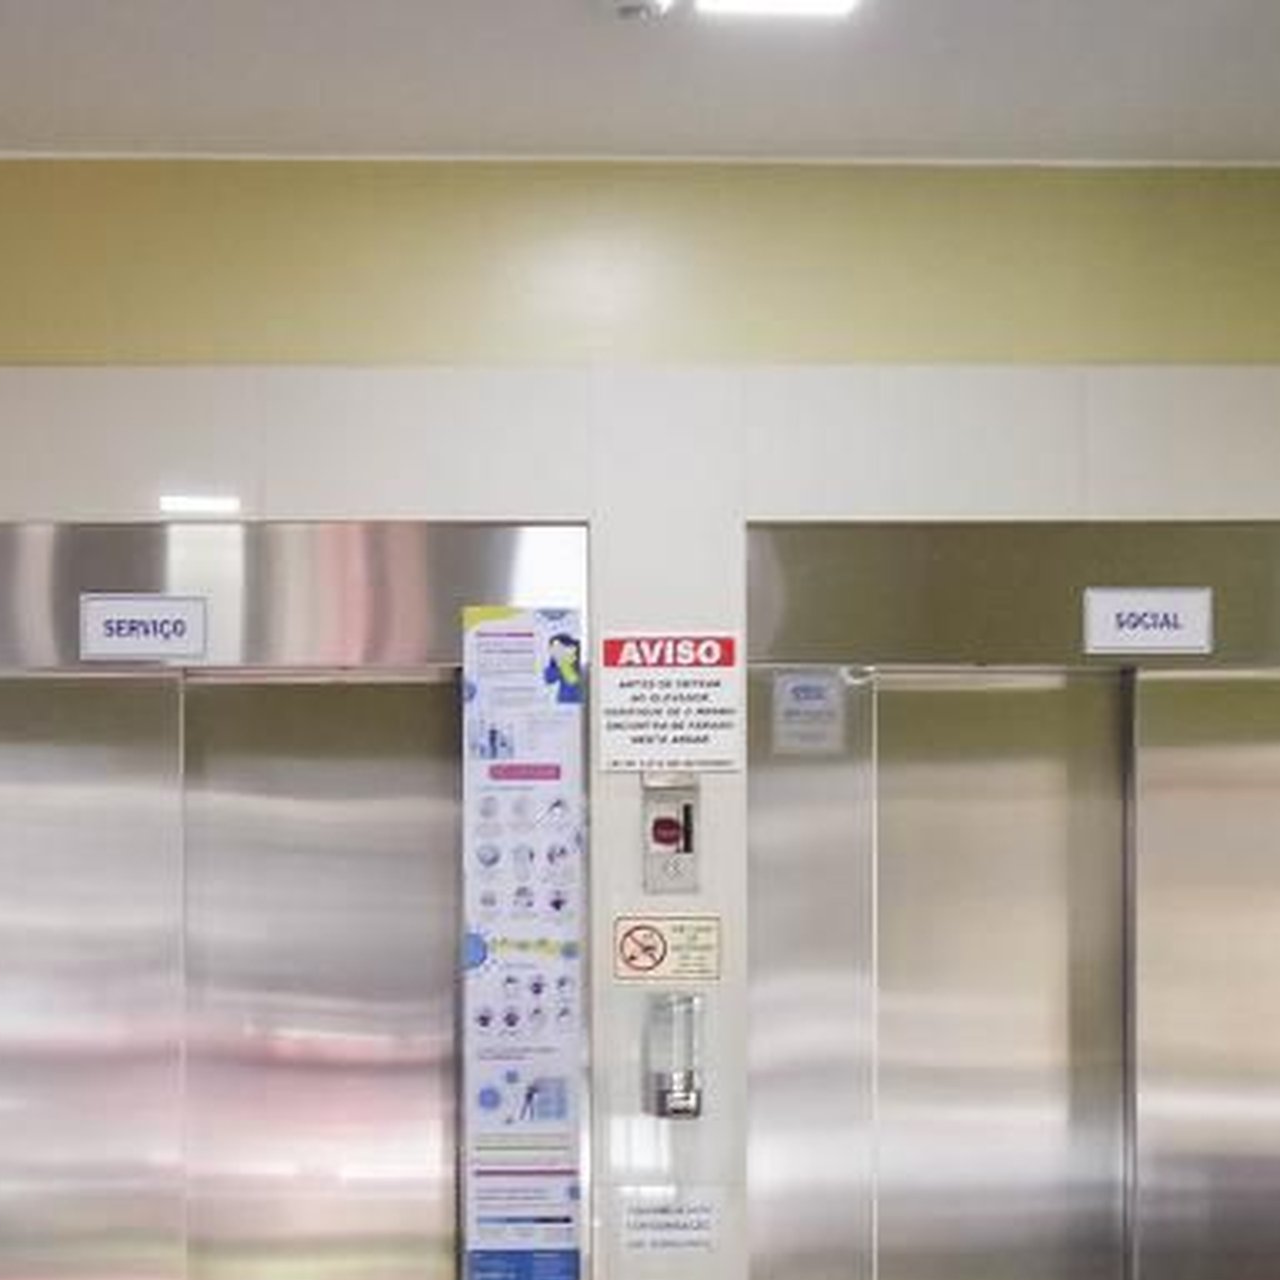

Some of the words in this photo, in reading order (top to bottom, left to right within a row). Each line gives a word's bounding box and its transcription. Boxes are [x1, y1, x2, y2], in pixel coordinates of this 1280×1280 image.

[104, 619, 186, 640] SERVIÇO
[1115, 612, 1183, 630] SOCIAL
[619, 639, 721, 665] AVISO
